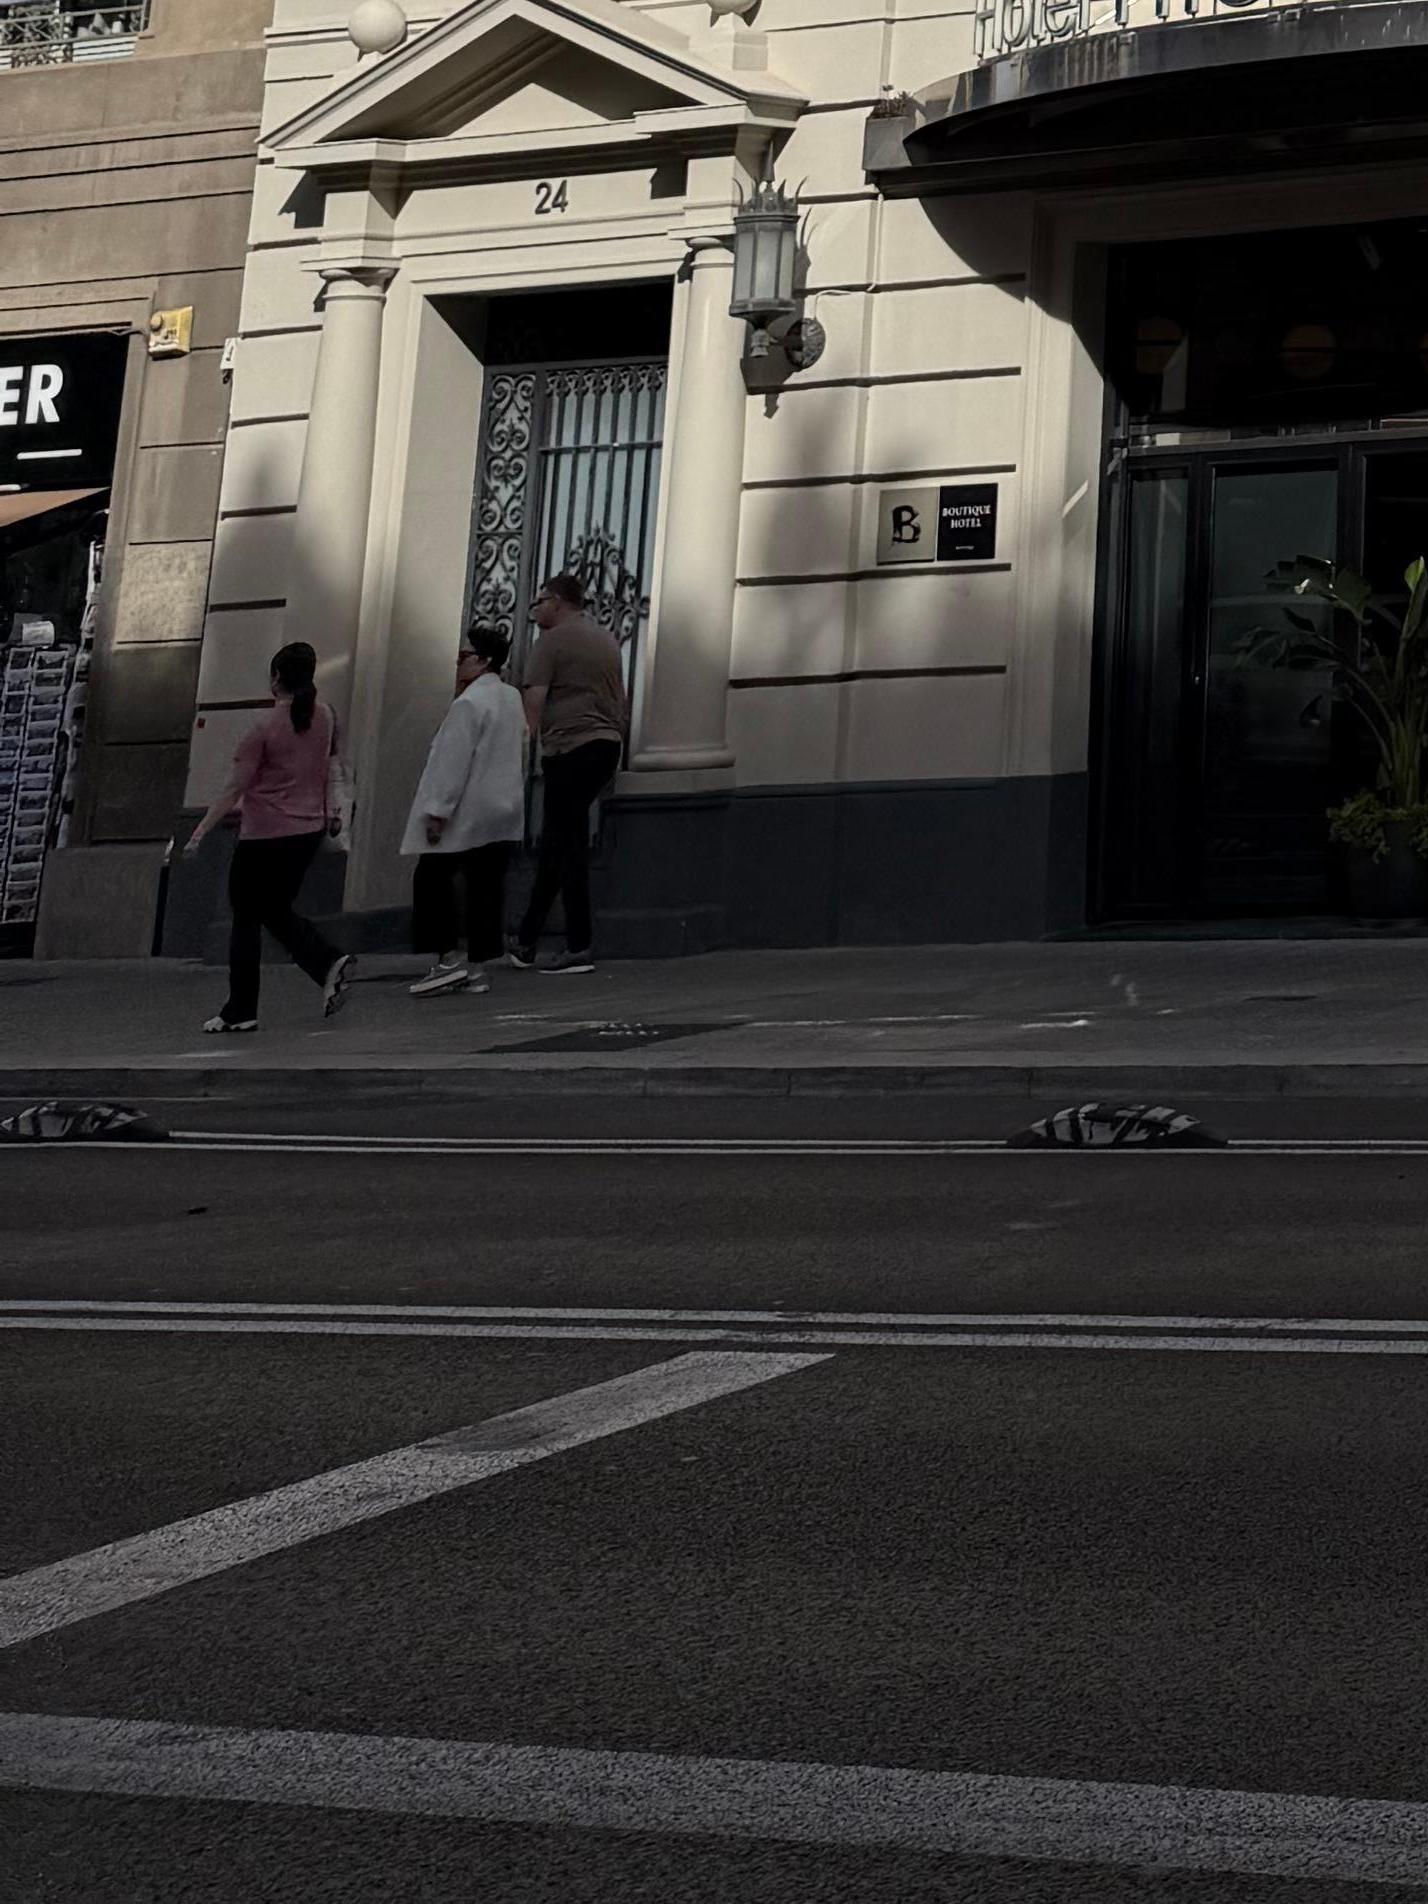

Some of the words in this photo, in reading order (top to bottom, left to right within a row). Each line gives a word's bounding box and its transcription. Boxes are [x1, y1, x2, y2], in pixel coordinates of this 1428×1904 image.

[534, 179, 569, 215] 24
[0, 363, 64, 426] ER
[891, 504, 921, 544] B
[942, 504, 992, 517] BOUTIQUE
[950, 517, 982, 529] HOTEL
